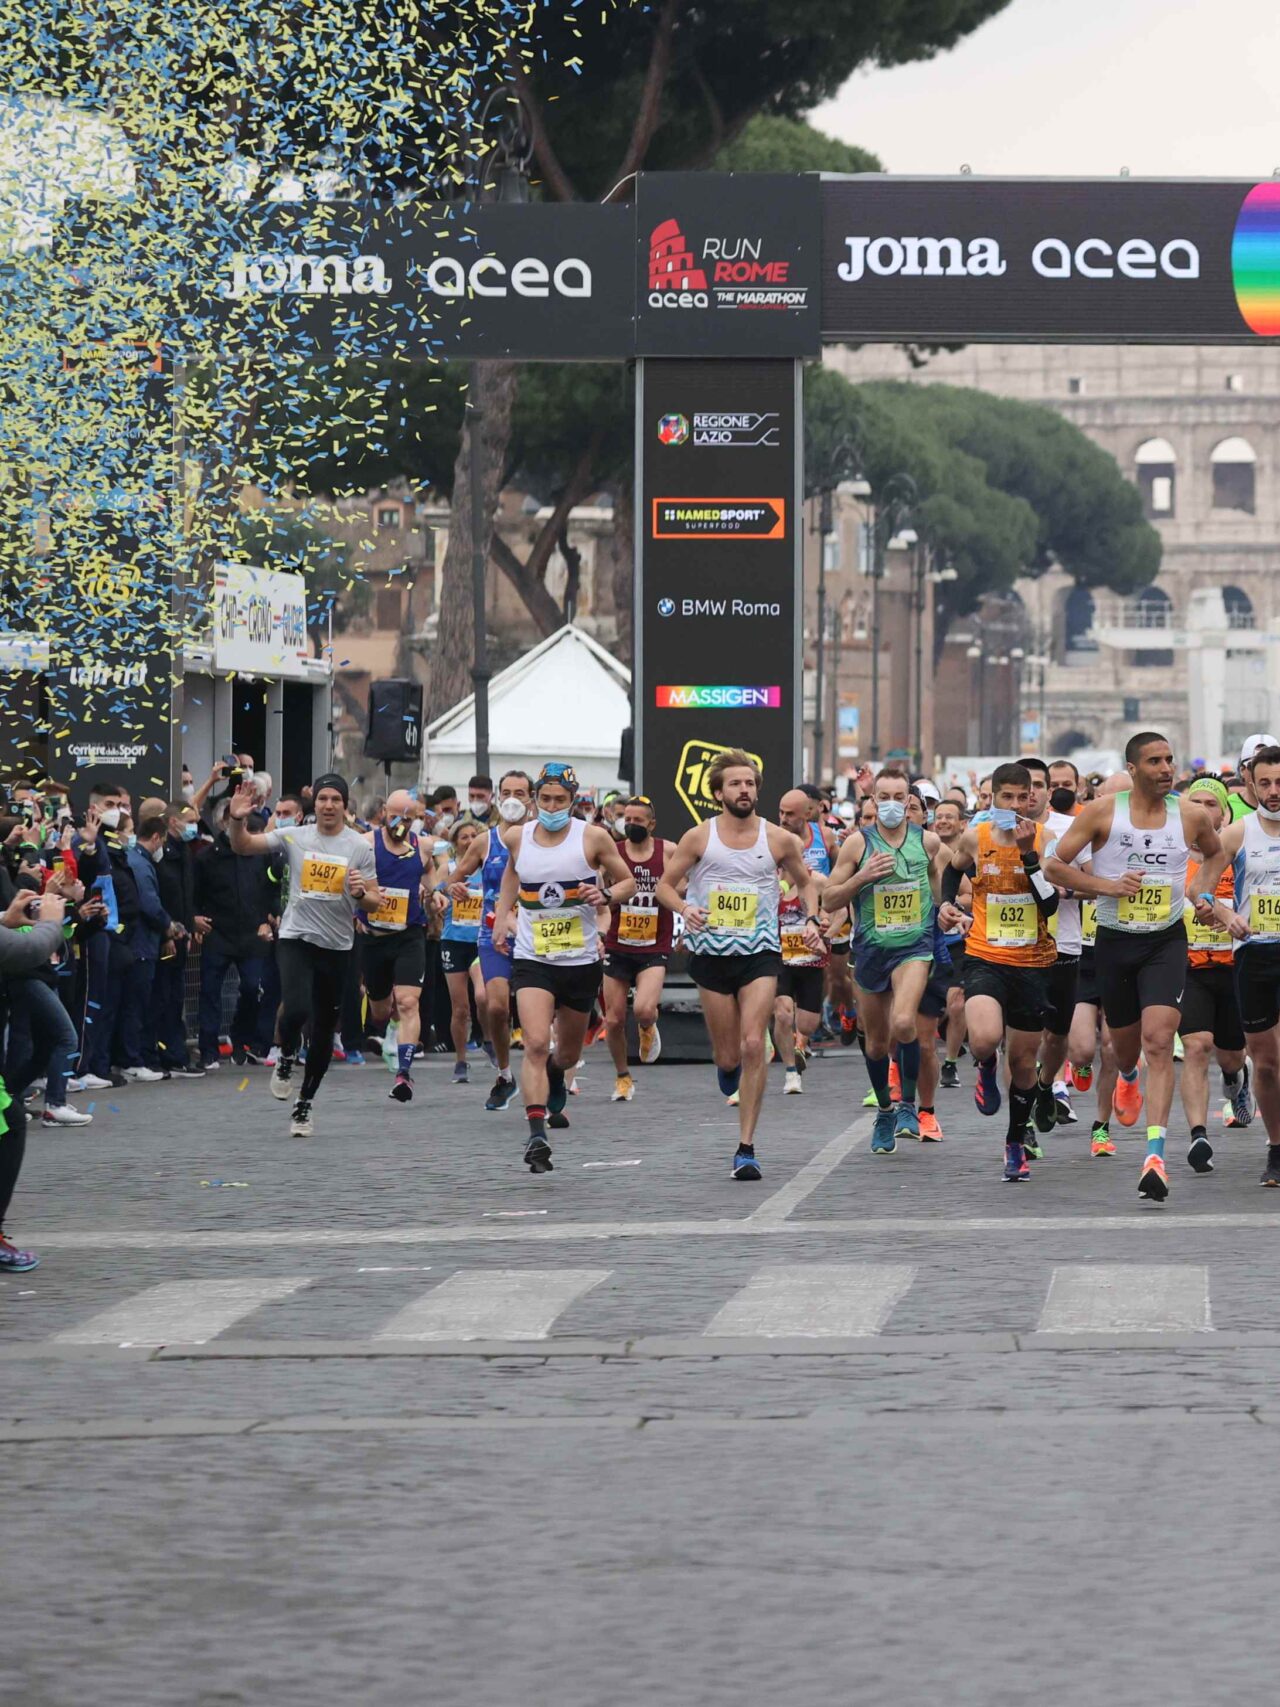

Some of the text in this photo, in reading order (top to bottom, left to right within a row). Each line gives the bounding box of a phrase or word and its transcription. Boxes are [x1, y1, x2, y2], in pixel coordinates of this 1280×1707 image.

[702, 238, 762, 260] RUN
[1031, 238, 1200, 278] acea
[427, 257, 593, 298] acea
[713, 261, 790, 282] ROME
[648, 292, 709, 308] acea
[717, 292, 806, 304] THE MARATHON
[693, 415, 750, 428] REGIONE
[693, 431, 733, 443] LAZIO
[685, 522, 741, 530] SUPERFOOD
[681, 600, 781, 616] BMW Roma
[669, 688, 769, 705] MASSIGEN
[310, 863, 338, 880] 3487
[718, 895, 748, 912] 8401
[884, 894, 913, 909] 8737
[626, 915, 650, 929] 5129
[1001, 907, 1025, 922] 632
[1128, 913, 1157, 922] 9 TOP
[541, 921, 572, 938] 5299
[734, 919, 744, 927] TOP
[1209, 934, 1219, 943] TOP
